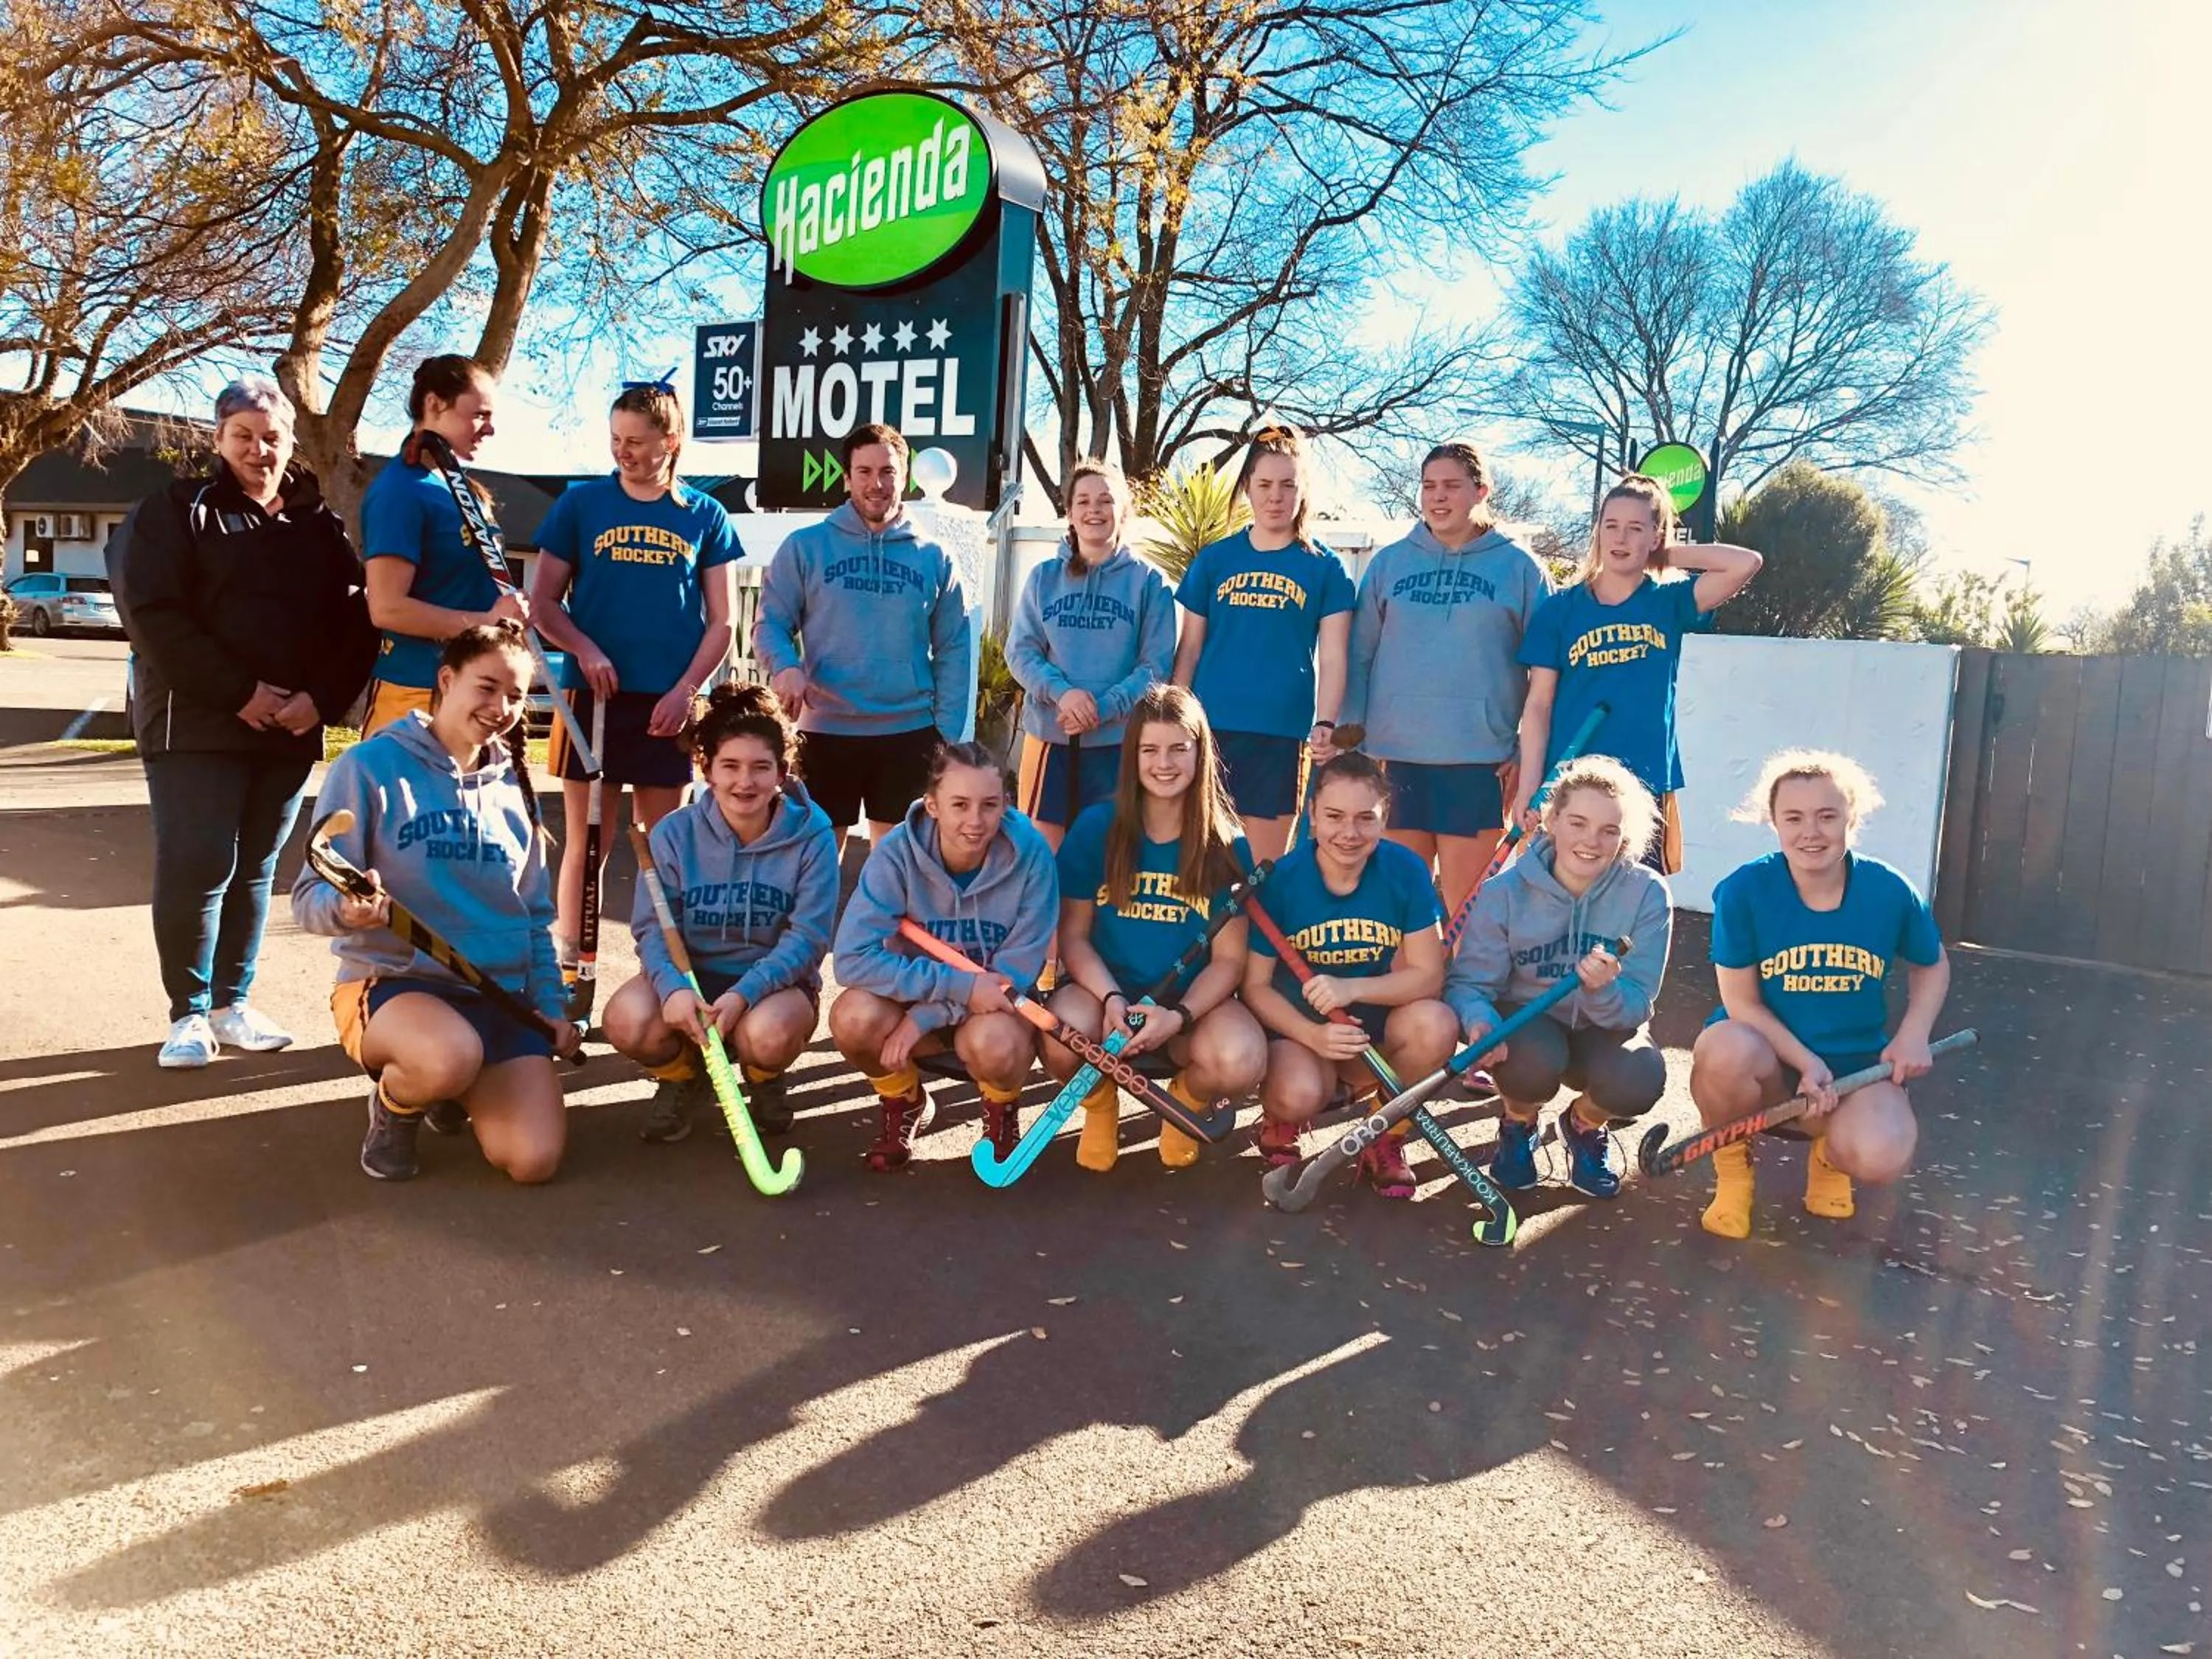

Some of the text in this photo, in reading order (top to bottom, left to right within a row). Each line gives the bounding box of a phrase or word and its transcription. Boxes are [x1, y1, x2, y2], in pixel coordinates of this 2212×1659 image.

[773, 116, 971, 285] Hacienda
[703, 334, 747, 358] SKY
[772, 358, 975, 438] MOTEL
[445, 470, 506, 571] MAZON
[611, 546, 677, 566] HOCKEY
[844, 577, 906, 594] HOCKEY
[1218, 571, 1307, 611] SOUTHERN
[1393, 569, 1496, 602] SOUTHERN
[1410, 591, 1475, 605] HOCKEY
[1229, 592, 1289, 610] HOCKEY
[1058, 614, 1116, 629] HOCKEY
[1568, 623, 1666, 667] SOUTHERN
[1587, 644, 1649, 667] HOCKEY
[1307, 947, 1384, 964] HOCKEY
[1760, 943, 1885, 981] SOUTHERN
[1783, 974, 1865, 992] HOCKEY
[1684, 1112, 1769, 1162] GRYPH
[1416, 1108, 1498, 1205] KOOKABURRA
